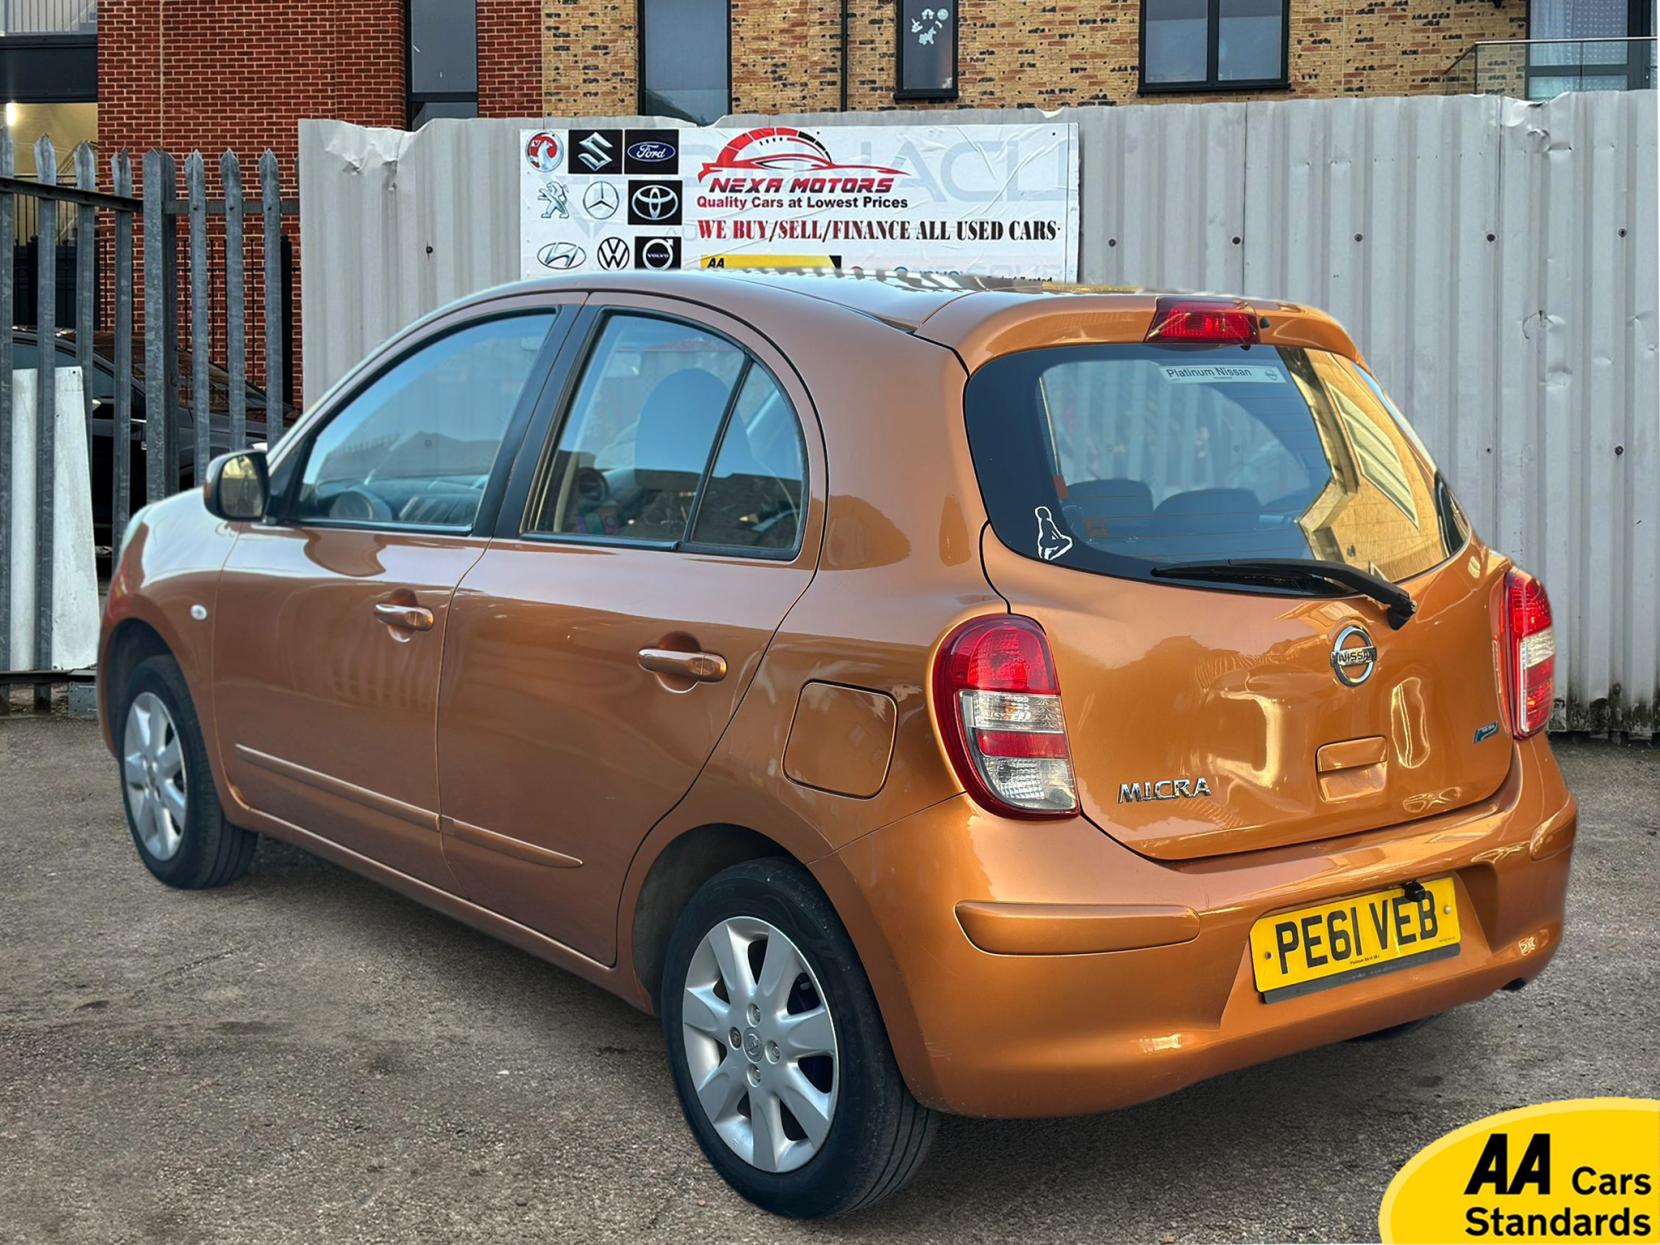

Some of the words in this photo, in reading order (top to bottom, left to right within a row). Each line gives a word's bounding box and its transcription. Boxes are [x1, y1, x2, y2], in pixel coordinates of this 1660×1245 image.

[636, 143, 666, 159] Ford
[709, 177, 783, 193] NEXA
[789, 177, 894, 193] MOTORS
[697, 195, 747, 210] Quality
[752, 195, 784, 208] Cars
[788, 196, 803, 208] at
[807, 195, 859, 208] Lowest
[863, 195, 908, 208] Prices
[697, 219, 727, 240] WE
[917, 220, 951, 240] ALL
[957, 220, 1004, 240] USED
[707, 257, 725, 268] AA
[1166, 368, 1215, 378] Platinum
[1216, 367, 1252, 377] Nissan
[1118, 777, 1212, 804] MICRA
[1275, 907, 1363, 975] PE61
[1369, 890, 1439, 950] VEB
